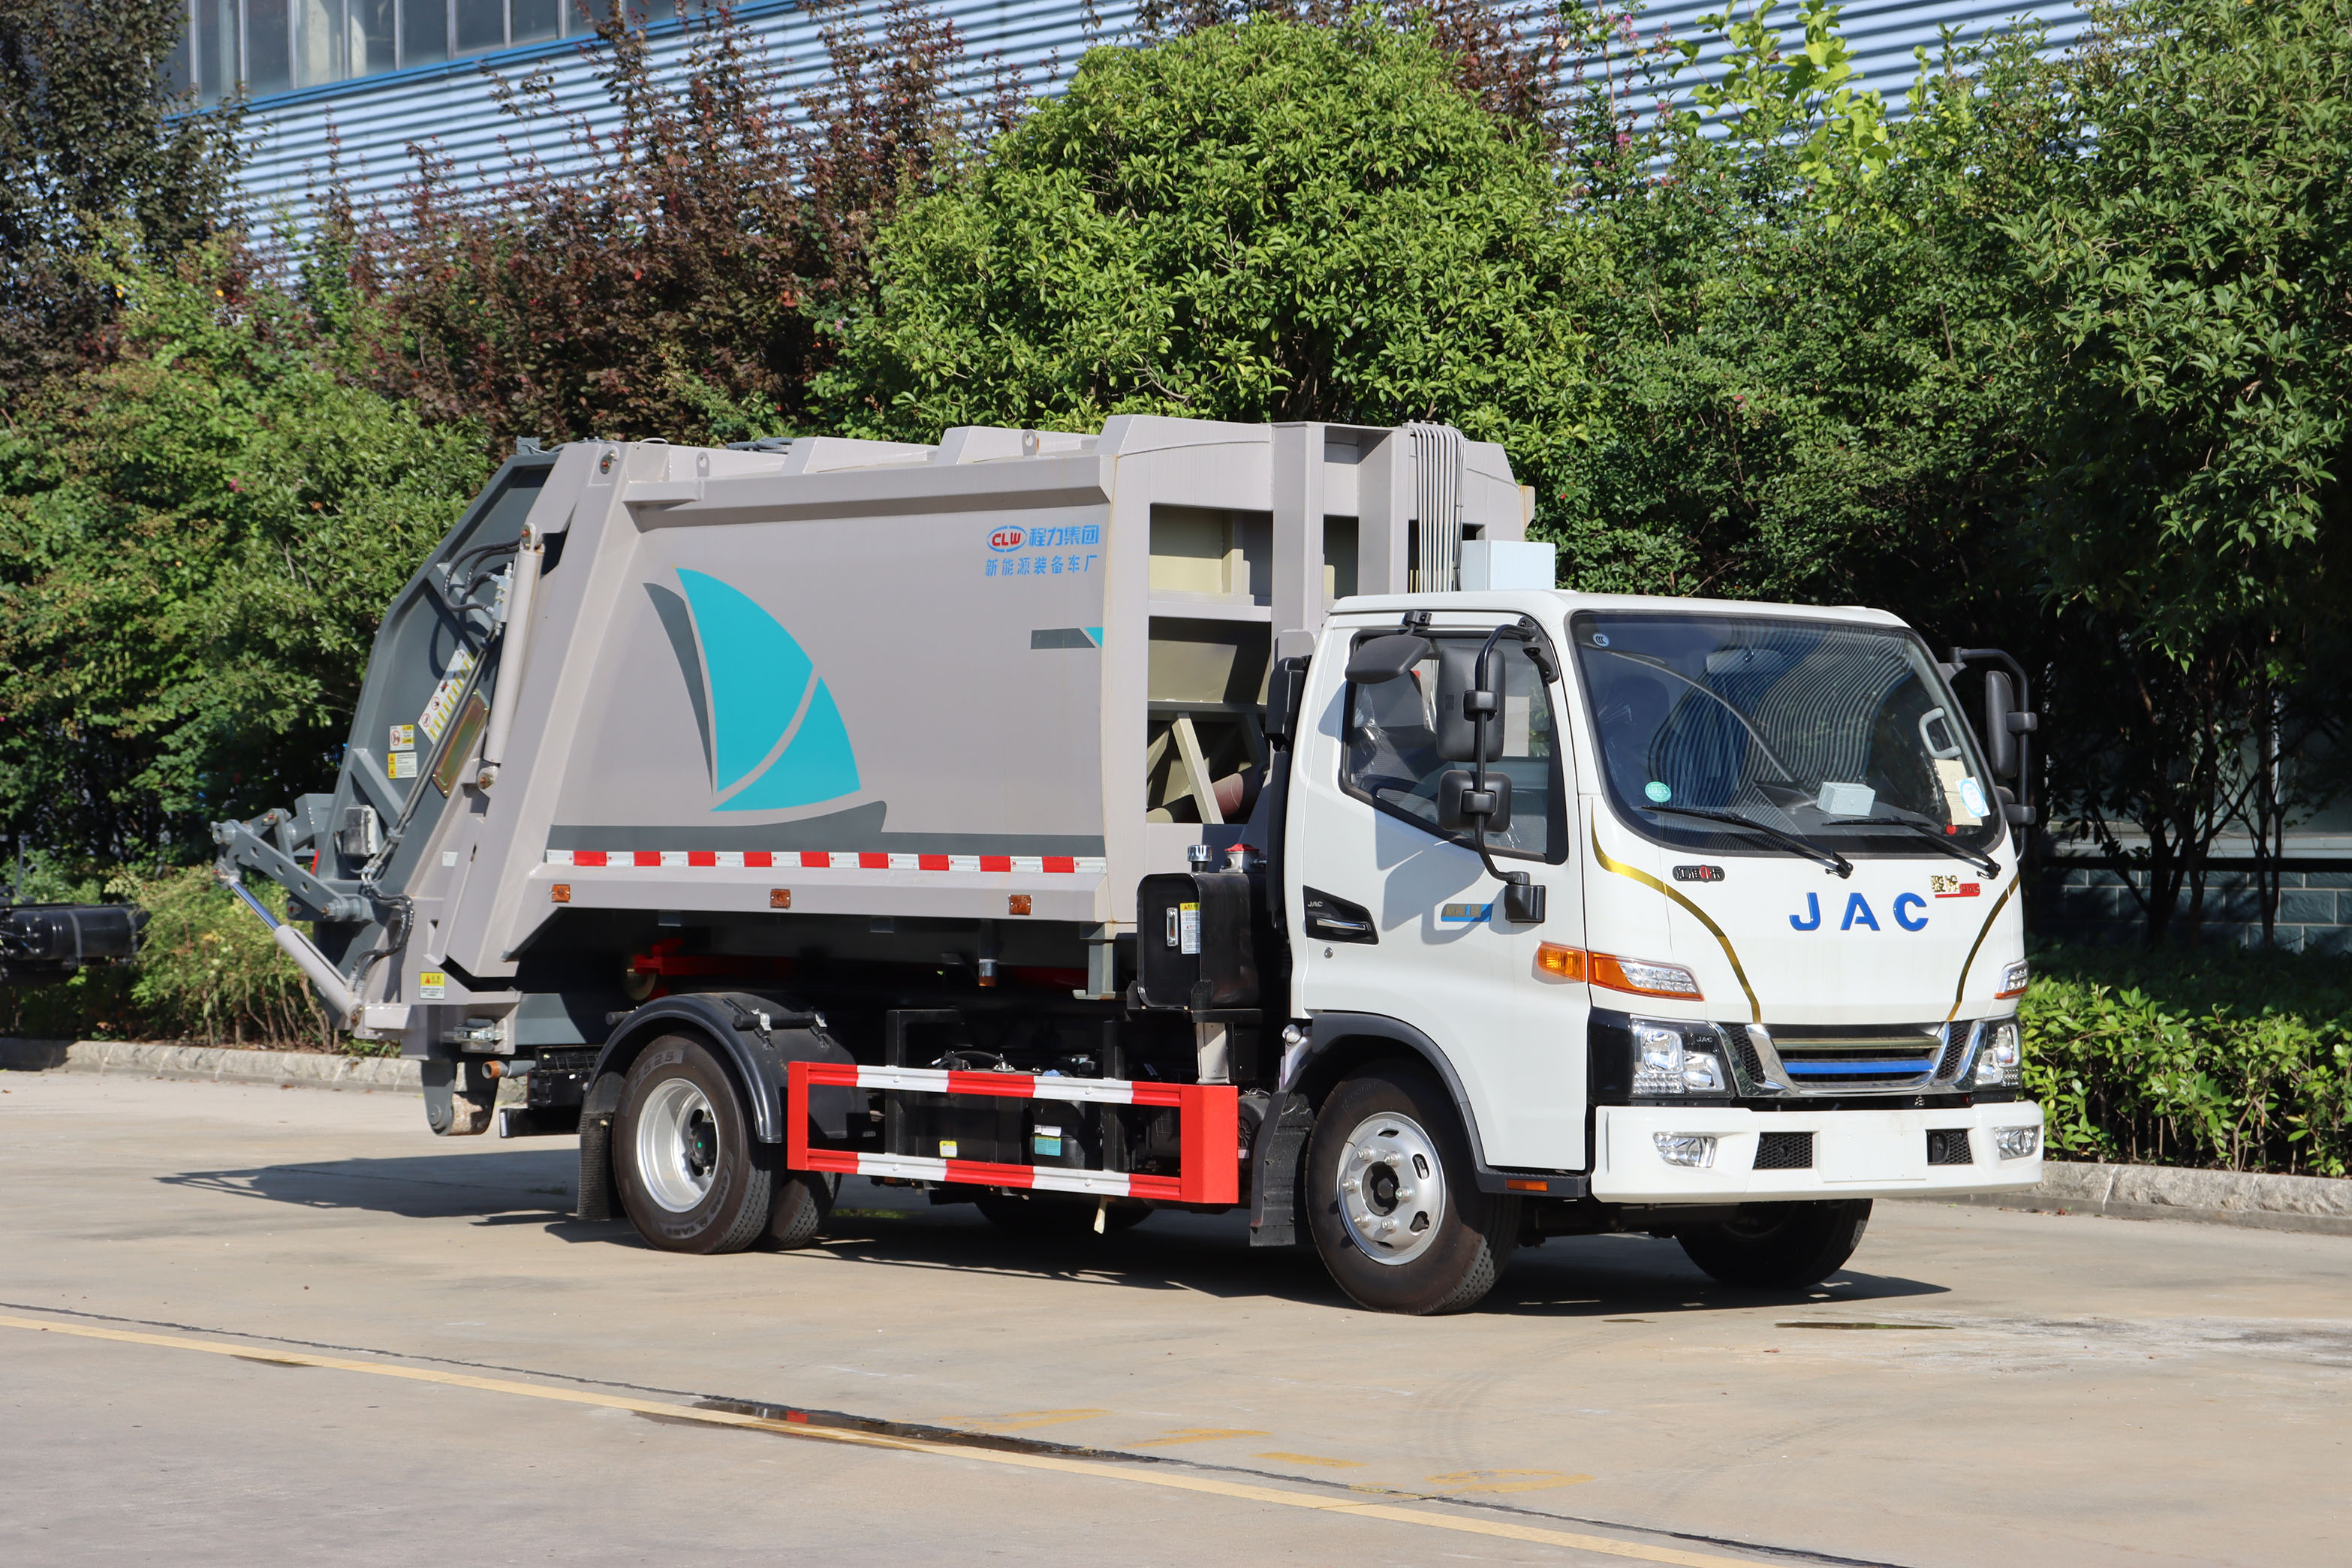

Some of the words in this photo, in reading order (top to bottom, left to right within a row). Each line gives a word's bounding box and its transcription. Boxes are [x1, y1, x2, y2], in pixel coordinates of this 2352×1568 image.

[992, 532, 1022, 547] CLW
[1028, 525, 1100, 546] 程力集团
[984, 554, 1098, 577] 新能源装备车厂
[1789, 892, 1929, 932] JAC
